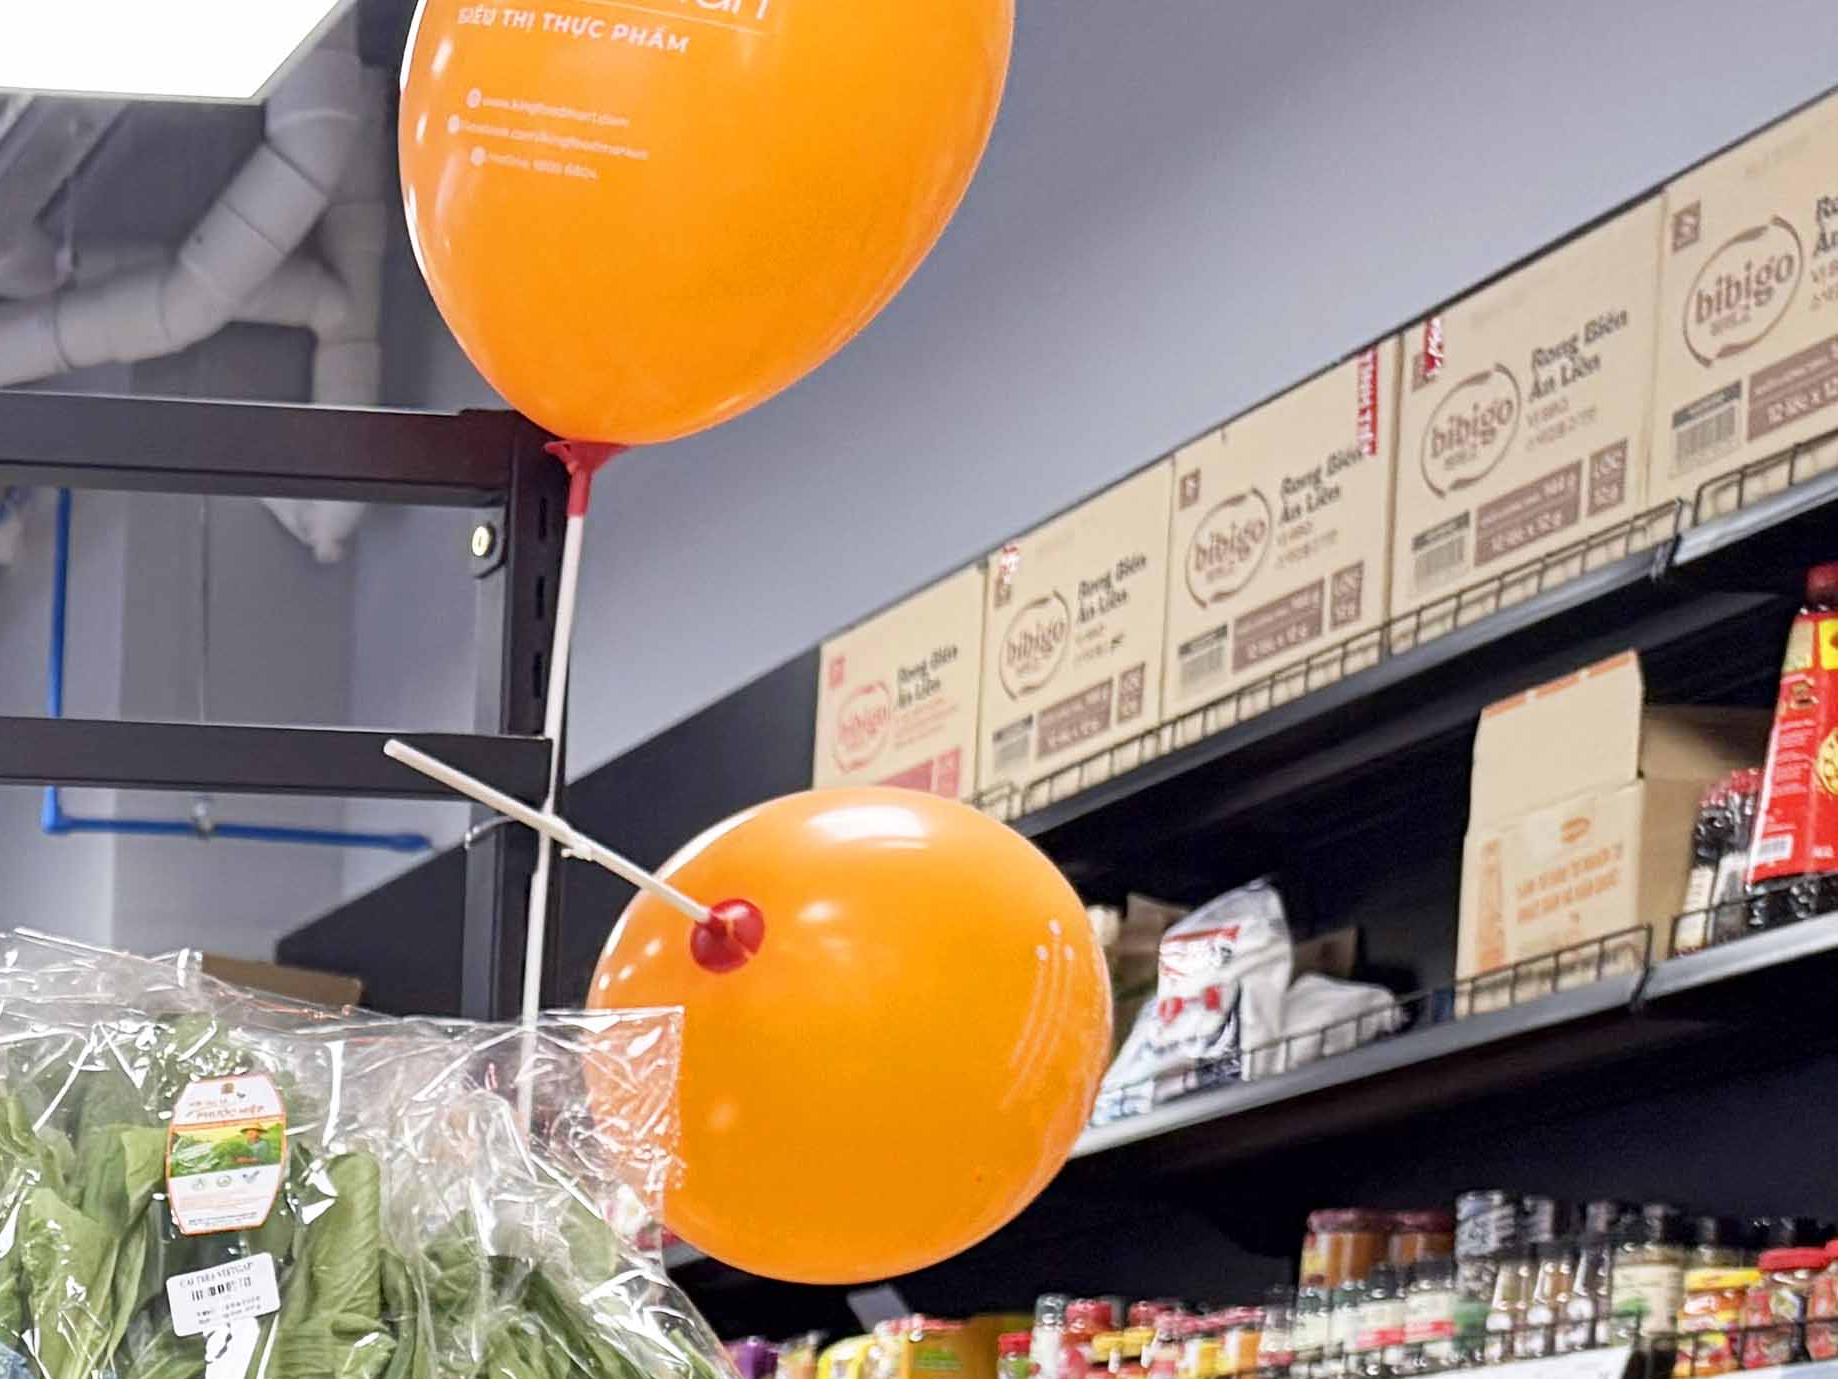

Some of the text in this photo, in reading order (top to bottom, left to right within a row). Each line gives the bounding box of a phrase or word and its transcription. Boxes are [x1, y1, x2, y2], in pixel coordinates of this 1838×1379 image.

[542, 11, 606, 39] THỰC
[611, 22, 690, 54] PHẨM
[1695, 252, 1794, 325] bibigo
[1430, 398, 1515, 459] bibigo
[1194, 518, 1267, 573] bibigo
[1006, 617, 1066, 665] bibigo
